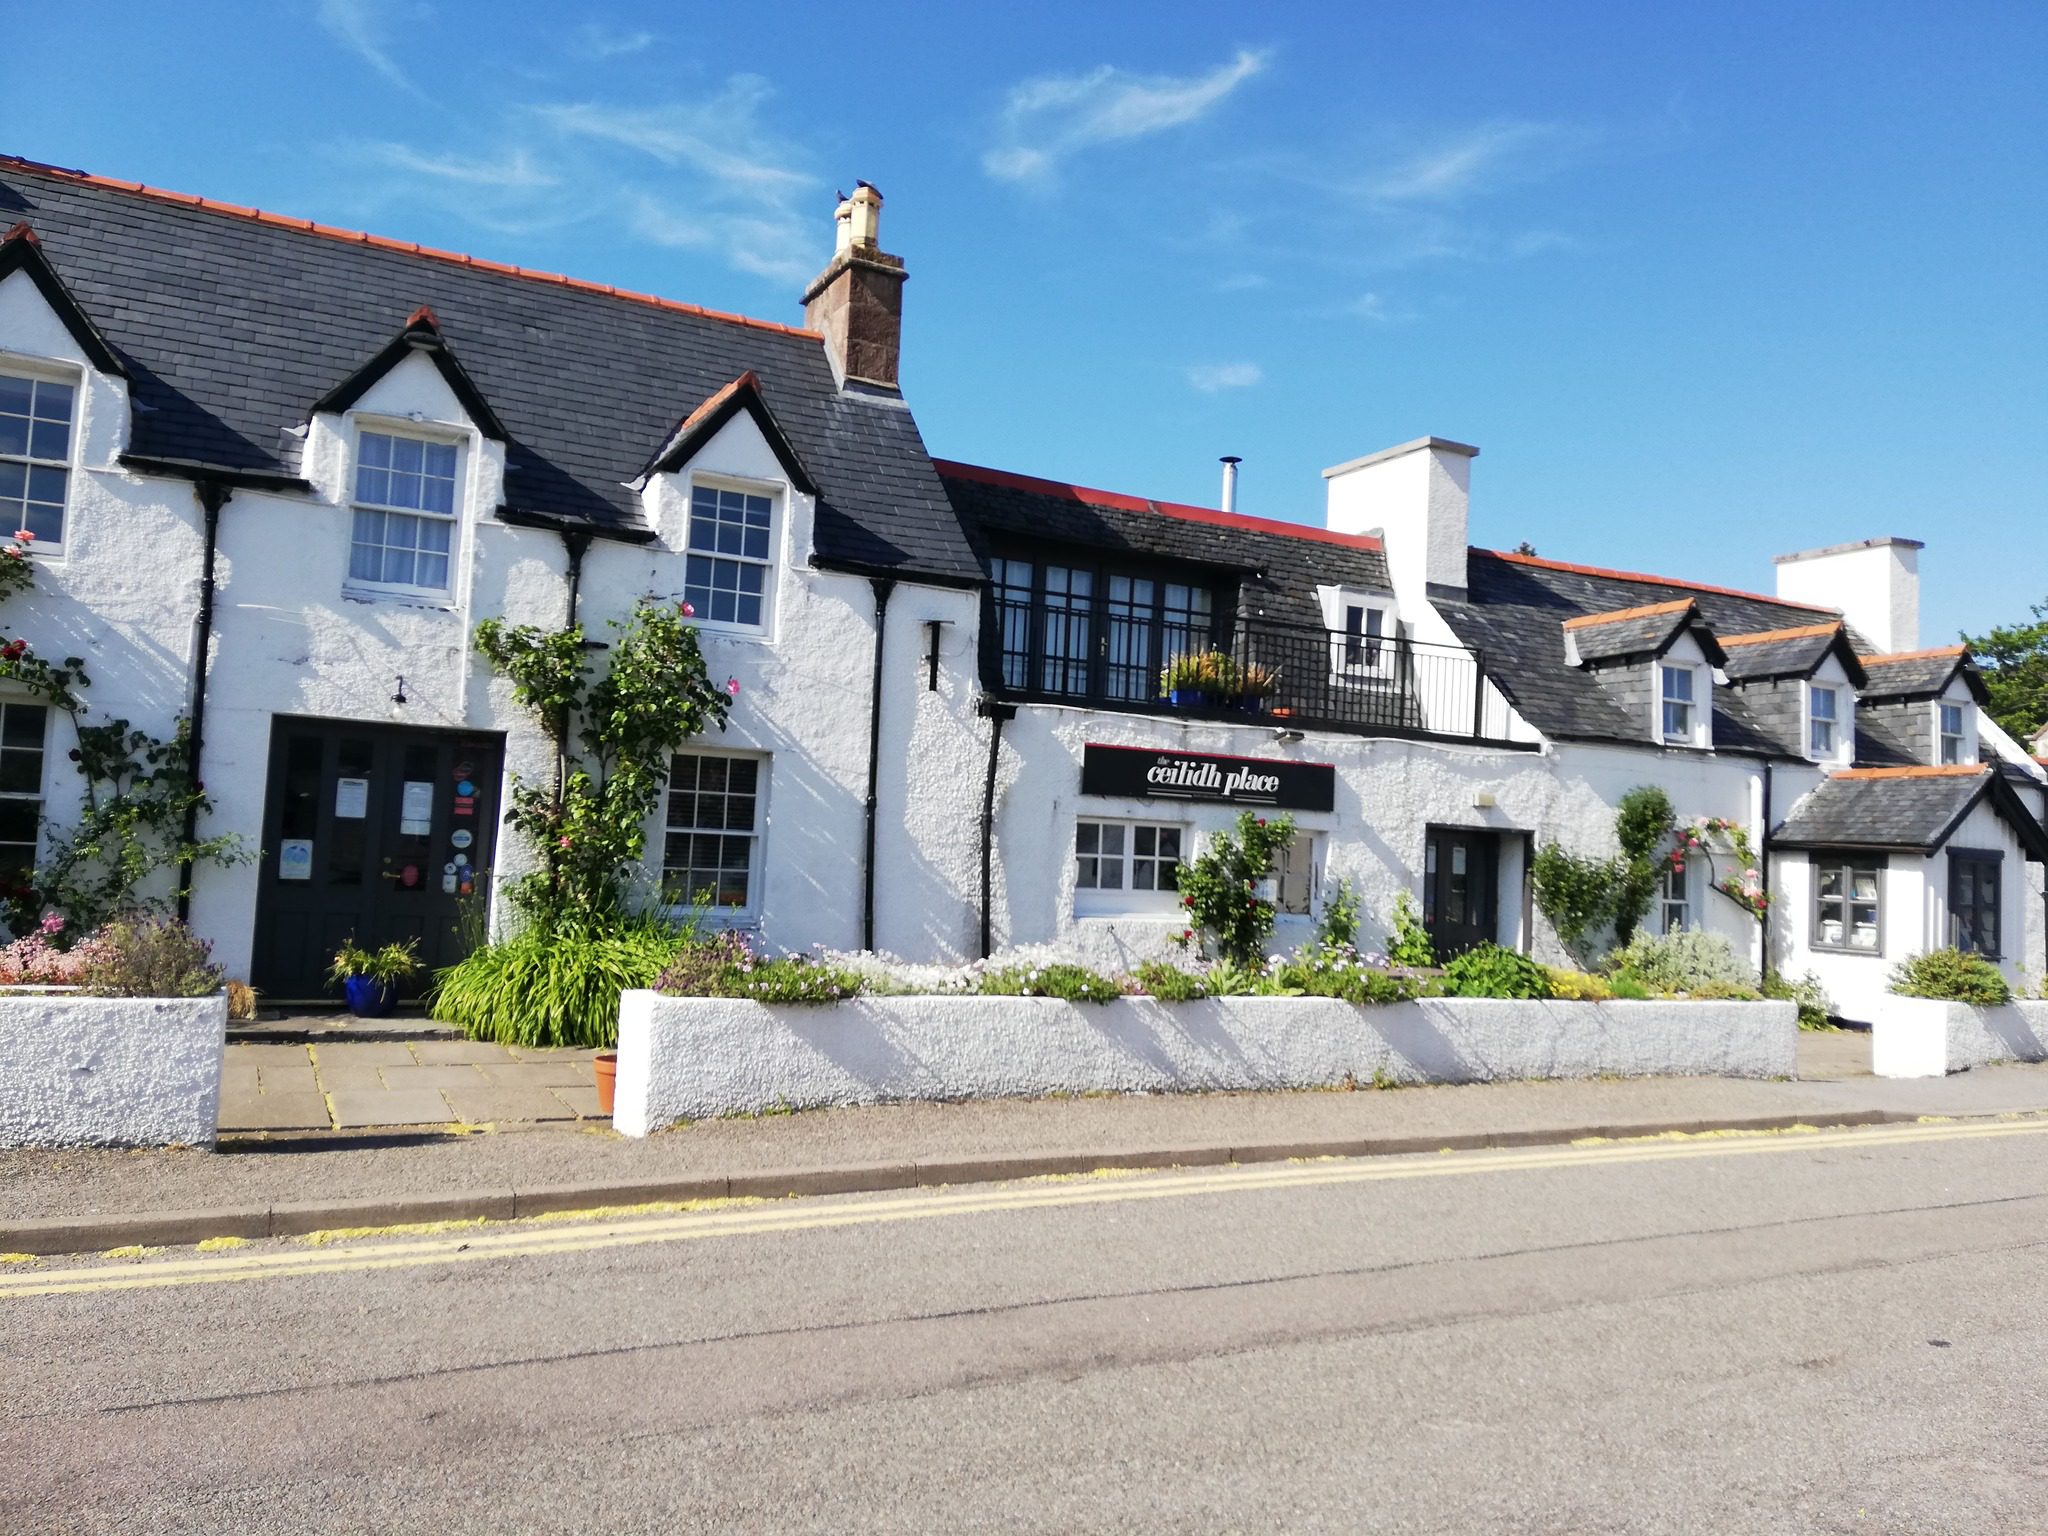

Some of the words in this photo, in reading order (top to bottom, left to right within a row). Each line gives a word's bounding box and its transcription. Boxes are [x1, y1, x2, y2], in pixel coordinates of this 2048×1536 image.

[1157, 756, 1170, 765] the
[1147, 760, 1222, 788] ceilidh
[1221, 766, 1280, 796] place
